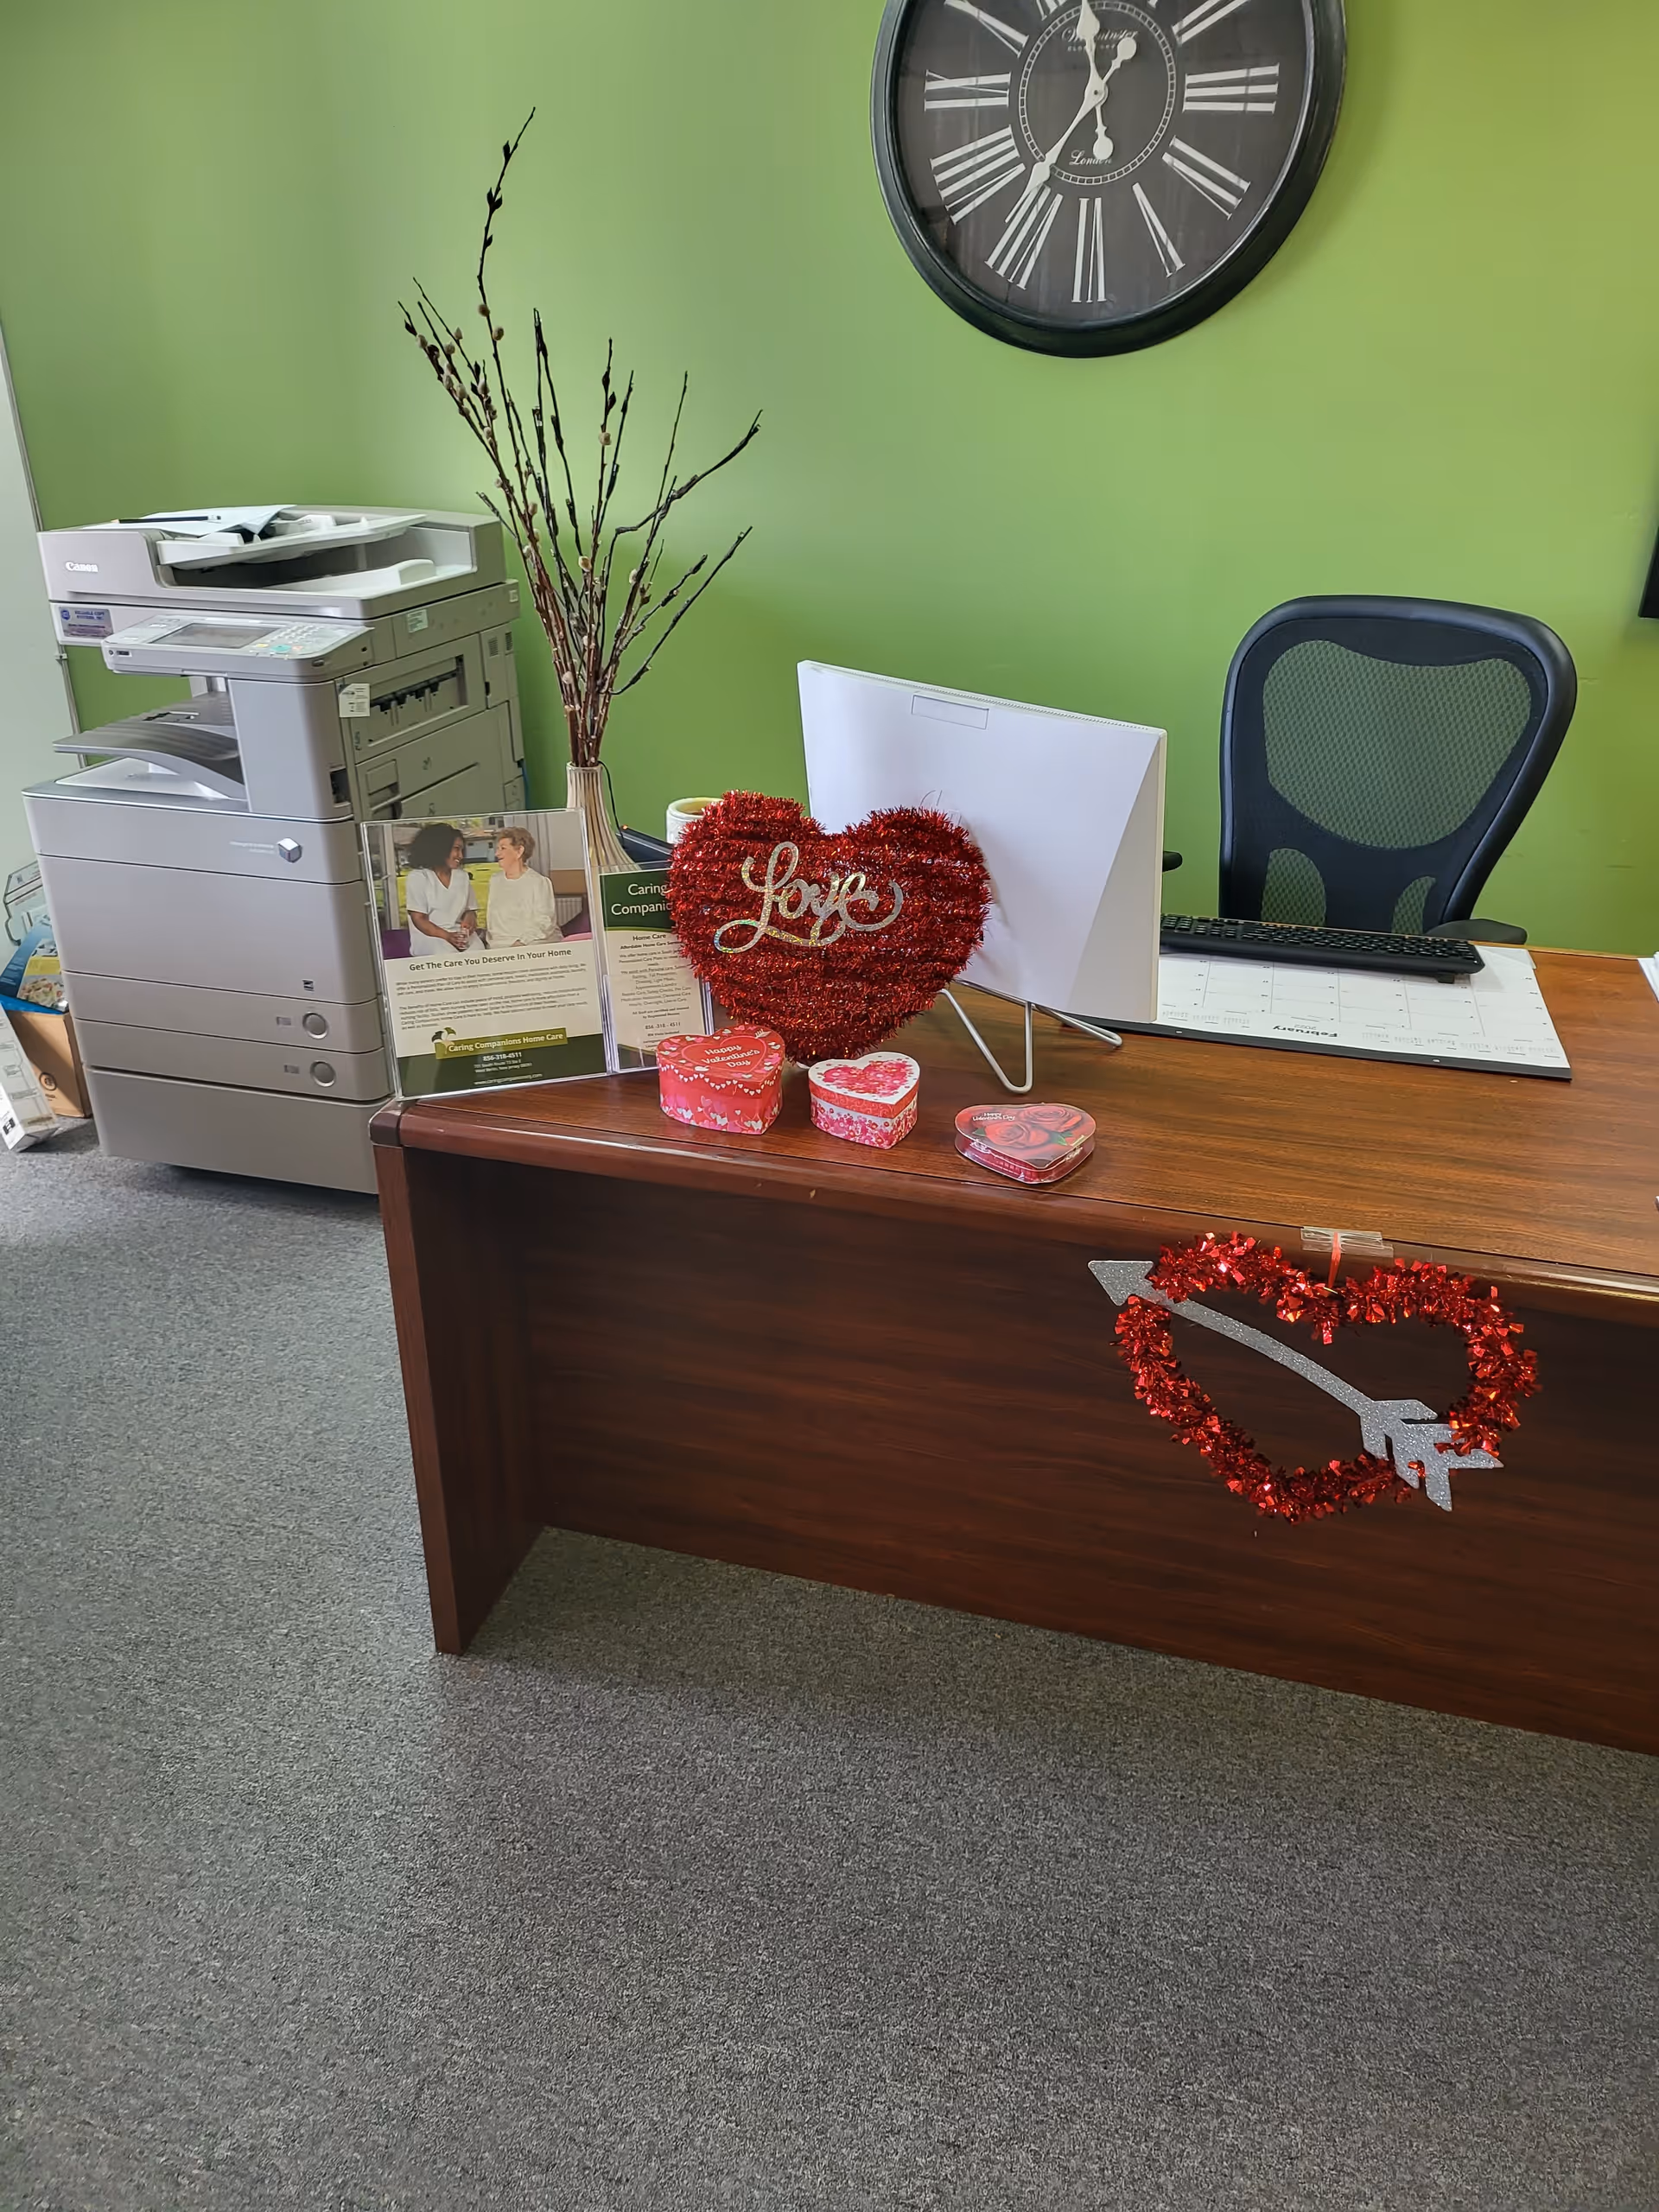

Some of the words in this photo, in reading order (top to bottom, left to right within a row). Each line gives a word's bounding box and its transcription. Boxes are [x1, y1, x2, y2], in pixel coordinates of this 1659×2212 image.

[925, 71, 1011, 111] IX
[1182, 63, 1280, 113] III
[930, 124, 1026, 225] VIII
[1132, 181, 1185, 278] V
[65, 561, 99, 572] Canon
[627, 883, 669, 896] Caring
[714, 841, 904, 953] Love
[482, 954, 516, 964] Deserve
[526, 951, 546, 960] Your
[547, 949, 572, 957] Home
[1273, 1025, 1338, 1037] February
[448, 1043, 474, 1052] Caring
[474, 1038, 522, 1049] Companions
[704, 1045, 742, 1055] Happy
[701, 1050, 760, 1064] Valentine's
